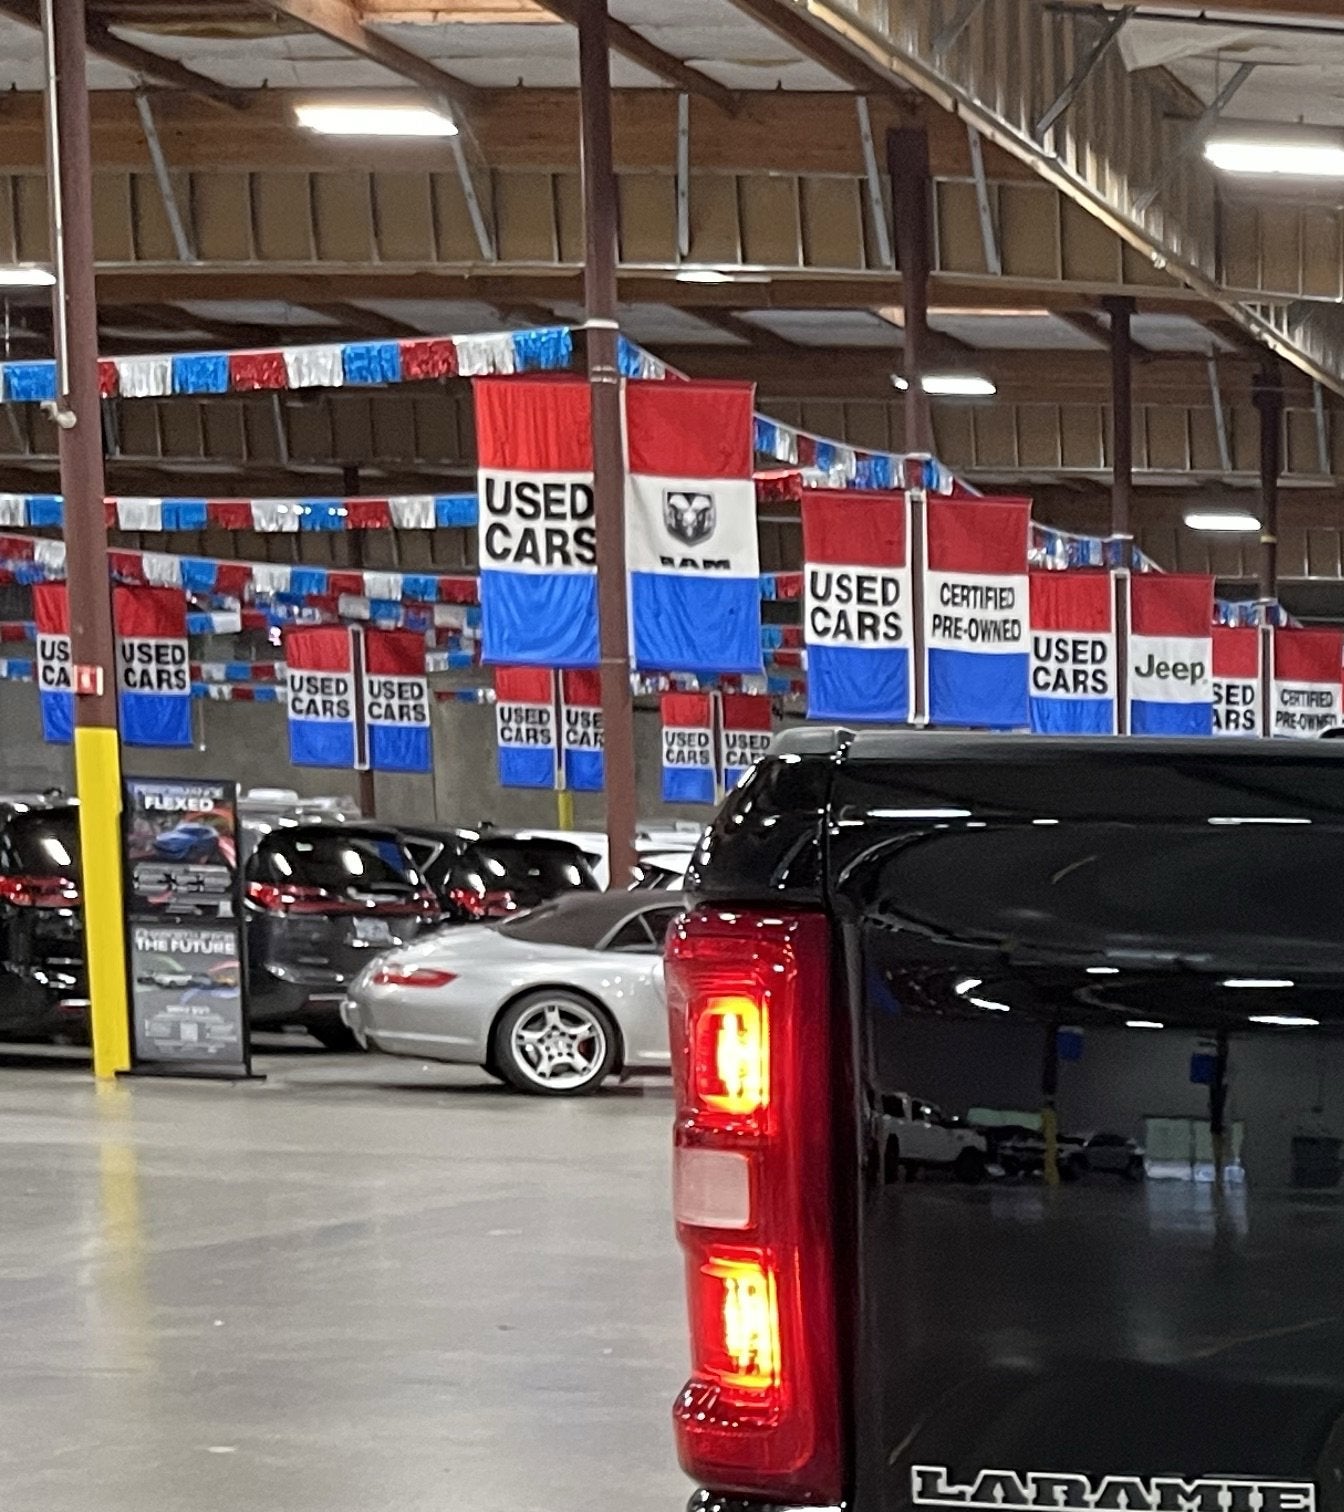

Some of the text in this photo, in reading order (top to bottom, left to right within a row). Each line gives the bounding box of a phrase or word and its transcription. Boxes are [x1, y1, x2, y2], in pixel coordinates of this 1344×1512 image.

[485, 478, 594, 521] USED
[485, 522, 596, 566] CARS
[810, 571, 900, 607] USED
[940, 583, 1015, 610] CERTIFIED
[810, 607, 903, 642] CARS
[932, 614, 1022, 643] PRE-OWNED
[40, 640, 70, 662] US
[121, 642, 186, 665] USED
[1034, 637, 1108, 665] USED
[42, 665, 71, 688] CA
[123, 668, 187, 690] CARS
[1033, 666, 1108, 694] CARS
[1135, 654, 1206, 686] Jeep
[291, 674, 348, 696] USED
[369, 679, 424, 700] USED
[1212, 683, 1255, 706] SED
[291, 697, 350, 718] CARS
[1280, 689, 1333, 708] CERTIFIED
[368, 702, 426, 722] CARS
[500, 707, 550, 725] USED
[566, 709, 602, 728] USE
[1212, 708, 1256, 731] ARS
[500, 727, 551, 744] CARS
[566, 729, 604, 747] CAR
[665, 731, 709, 747] USED
[725, 733, 770, 750] USED
[666, 749, 710, 764] CARS
[136, 938, 235, 955] THE FUTURE
